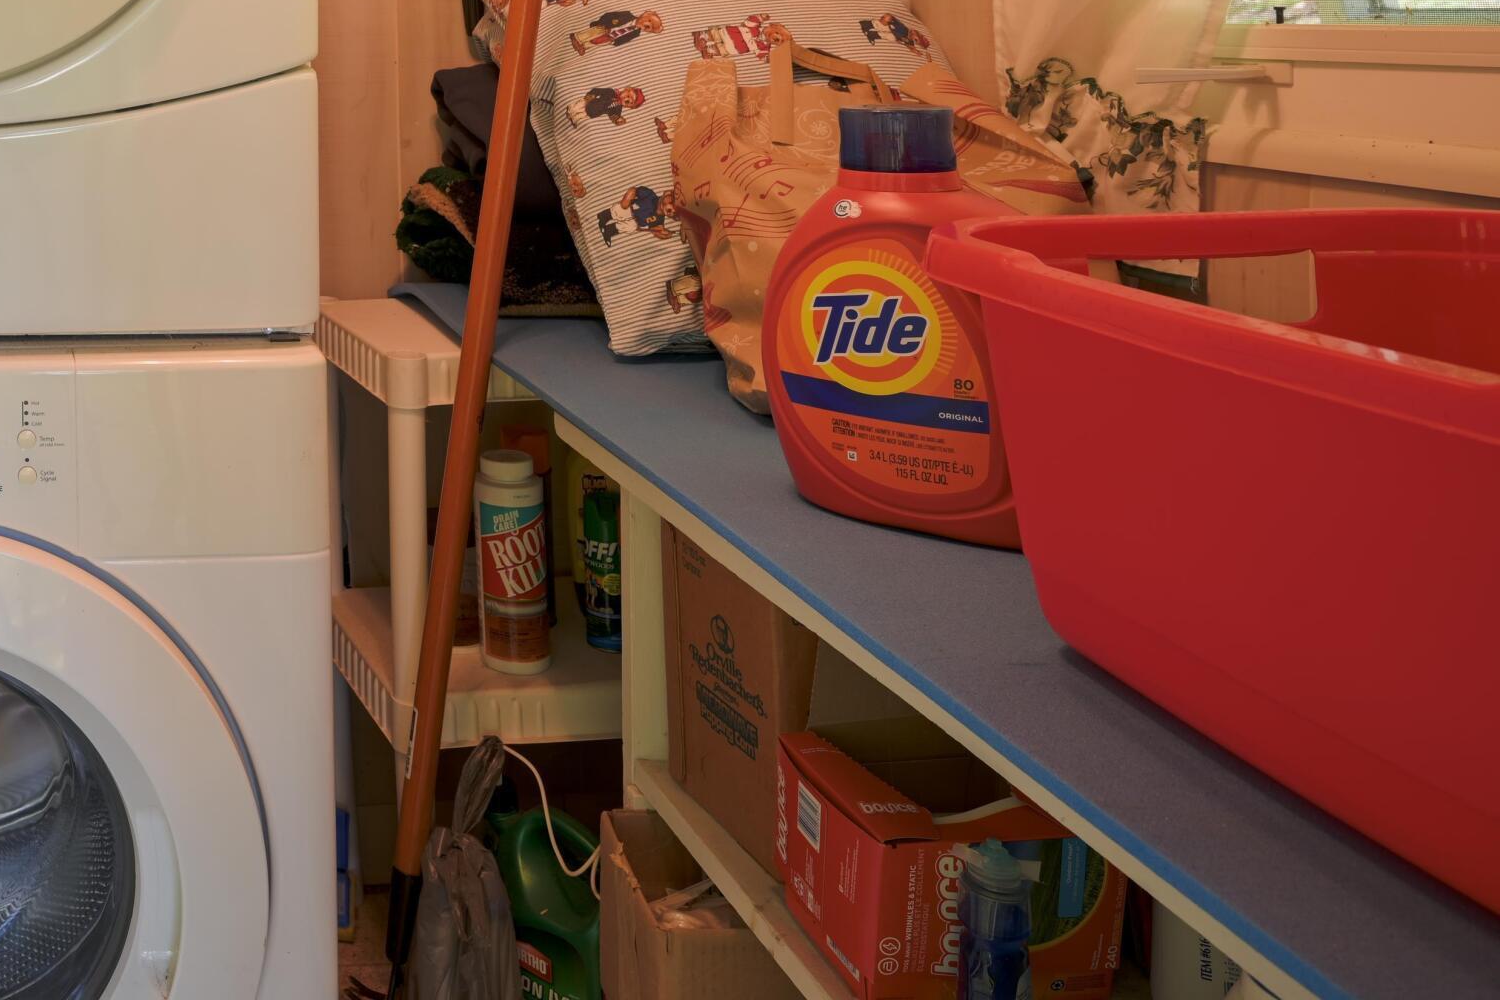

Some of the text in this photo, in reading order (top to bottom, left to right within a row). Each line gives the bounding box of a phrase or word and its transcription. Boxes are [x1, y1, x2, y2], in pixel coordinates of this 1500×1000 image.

[812, 294, 929, 366] Tide
[953, 378, 974, 391] 80
[938, 411, 983, 423] ORIGINAL
[868, 449, 881, 461] 3.4
[888, 452, 907, 465] (3.59
[909, 456, 920, 467] US
[922, 458, 951, 473] QT/PTE
[895, 467, 949, 485] 115 FL OZ LIQ.
[493, 510, 519, 524] DRAIN
[486, 519, 545, 570] ROOT
[706, 642, 742, 682] Orville
[858, 800, 917, 815] bounce
[908, 863, 917, 891] STATIC
[905, 898, 915, 940] WRINKLES
[517, 948, 548, 975] RTHO
[1104, 943, 1118, 968] 240
[1200, 959, 1213, 981] ITEM
